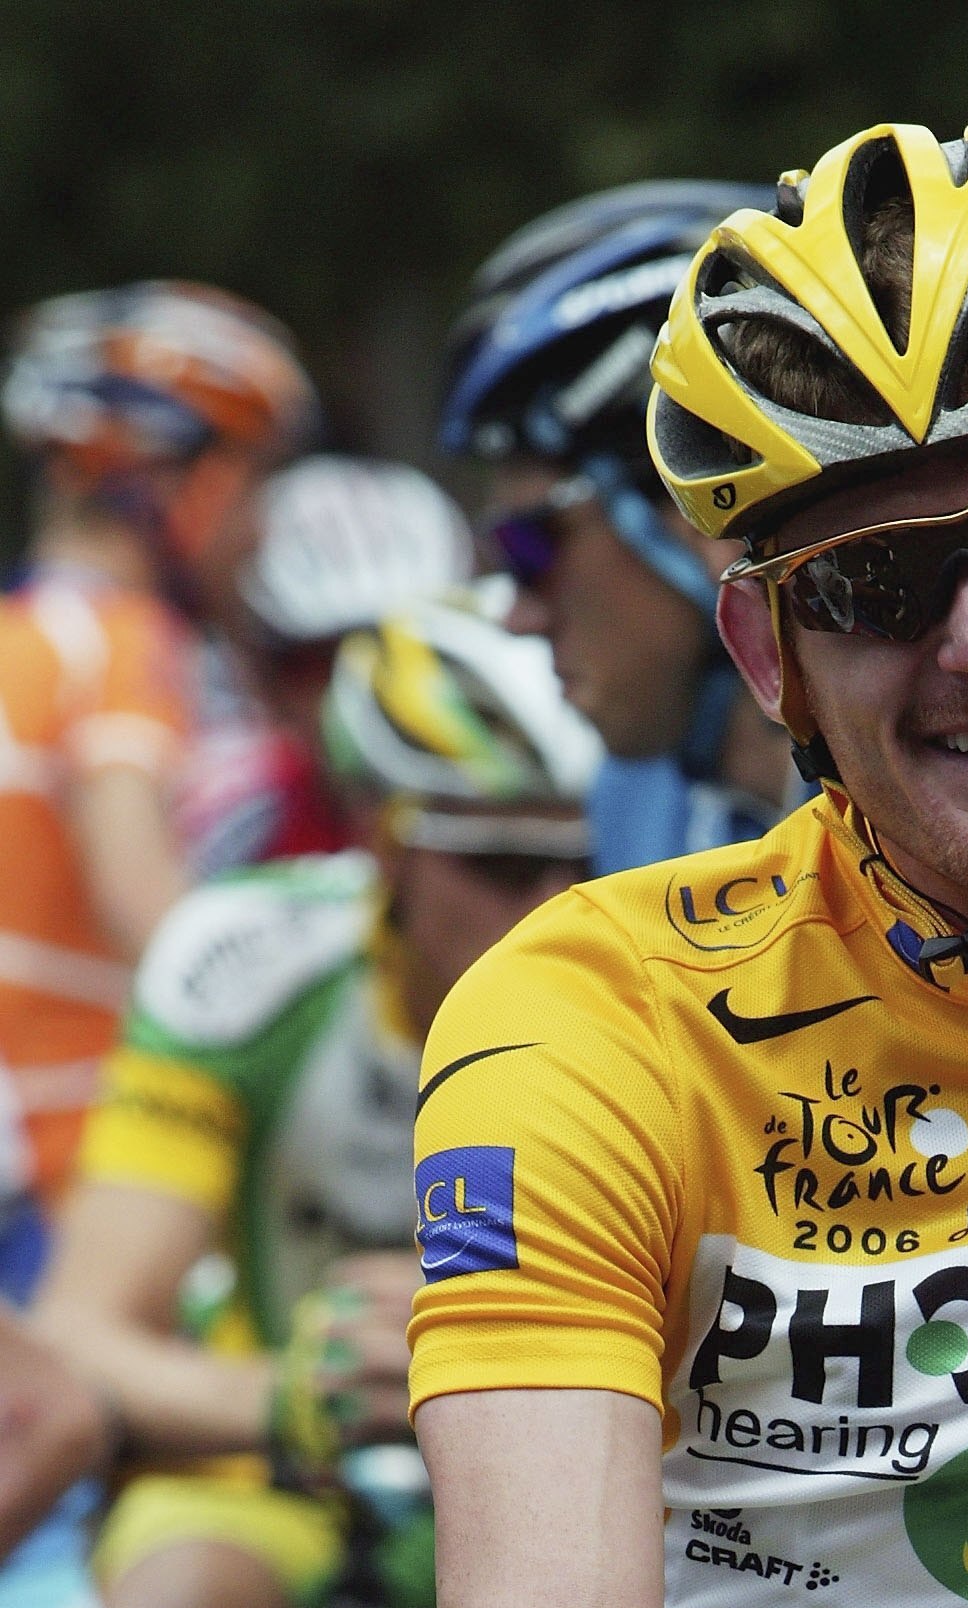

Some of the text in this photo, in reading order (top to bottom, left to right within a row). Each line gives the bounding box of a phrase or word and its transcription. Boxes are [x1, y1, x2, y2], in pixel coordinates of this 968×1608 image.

[793, 1220, 921, 1255] 2006
[694, 1389, 940, 1474] hearing
[685, 1538, 804, 1586] CRAFT
